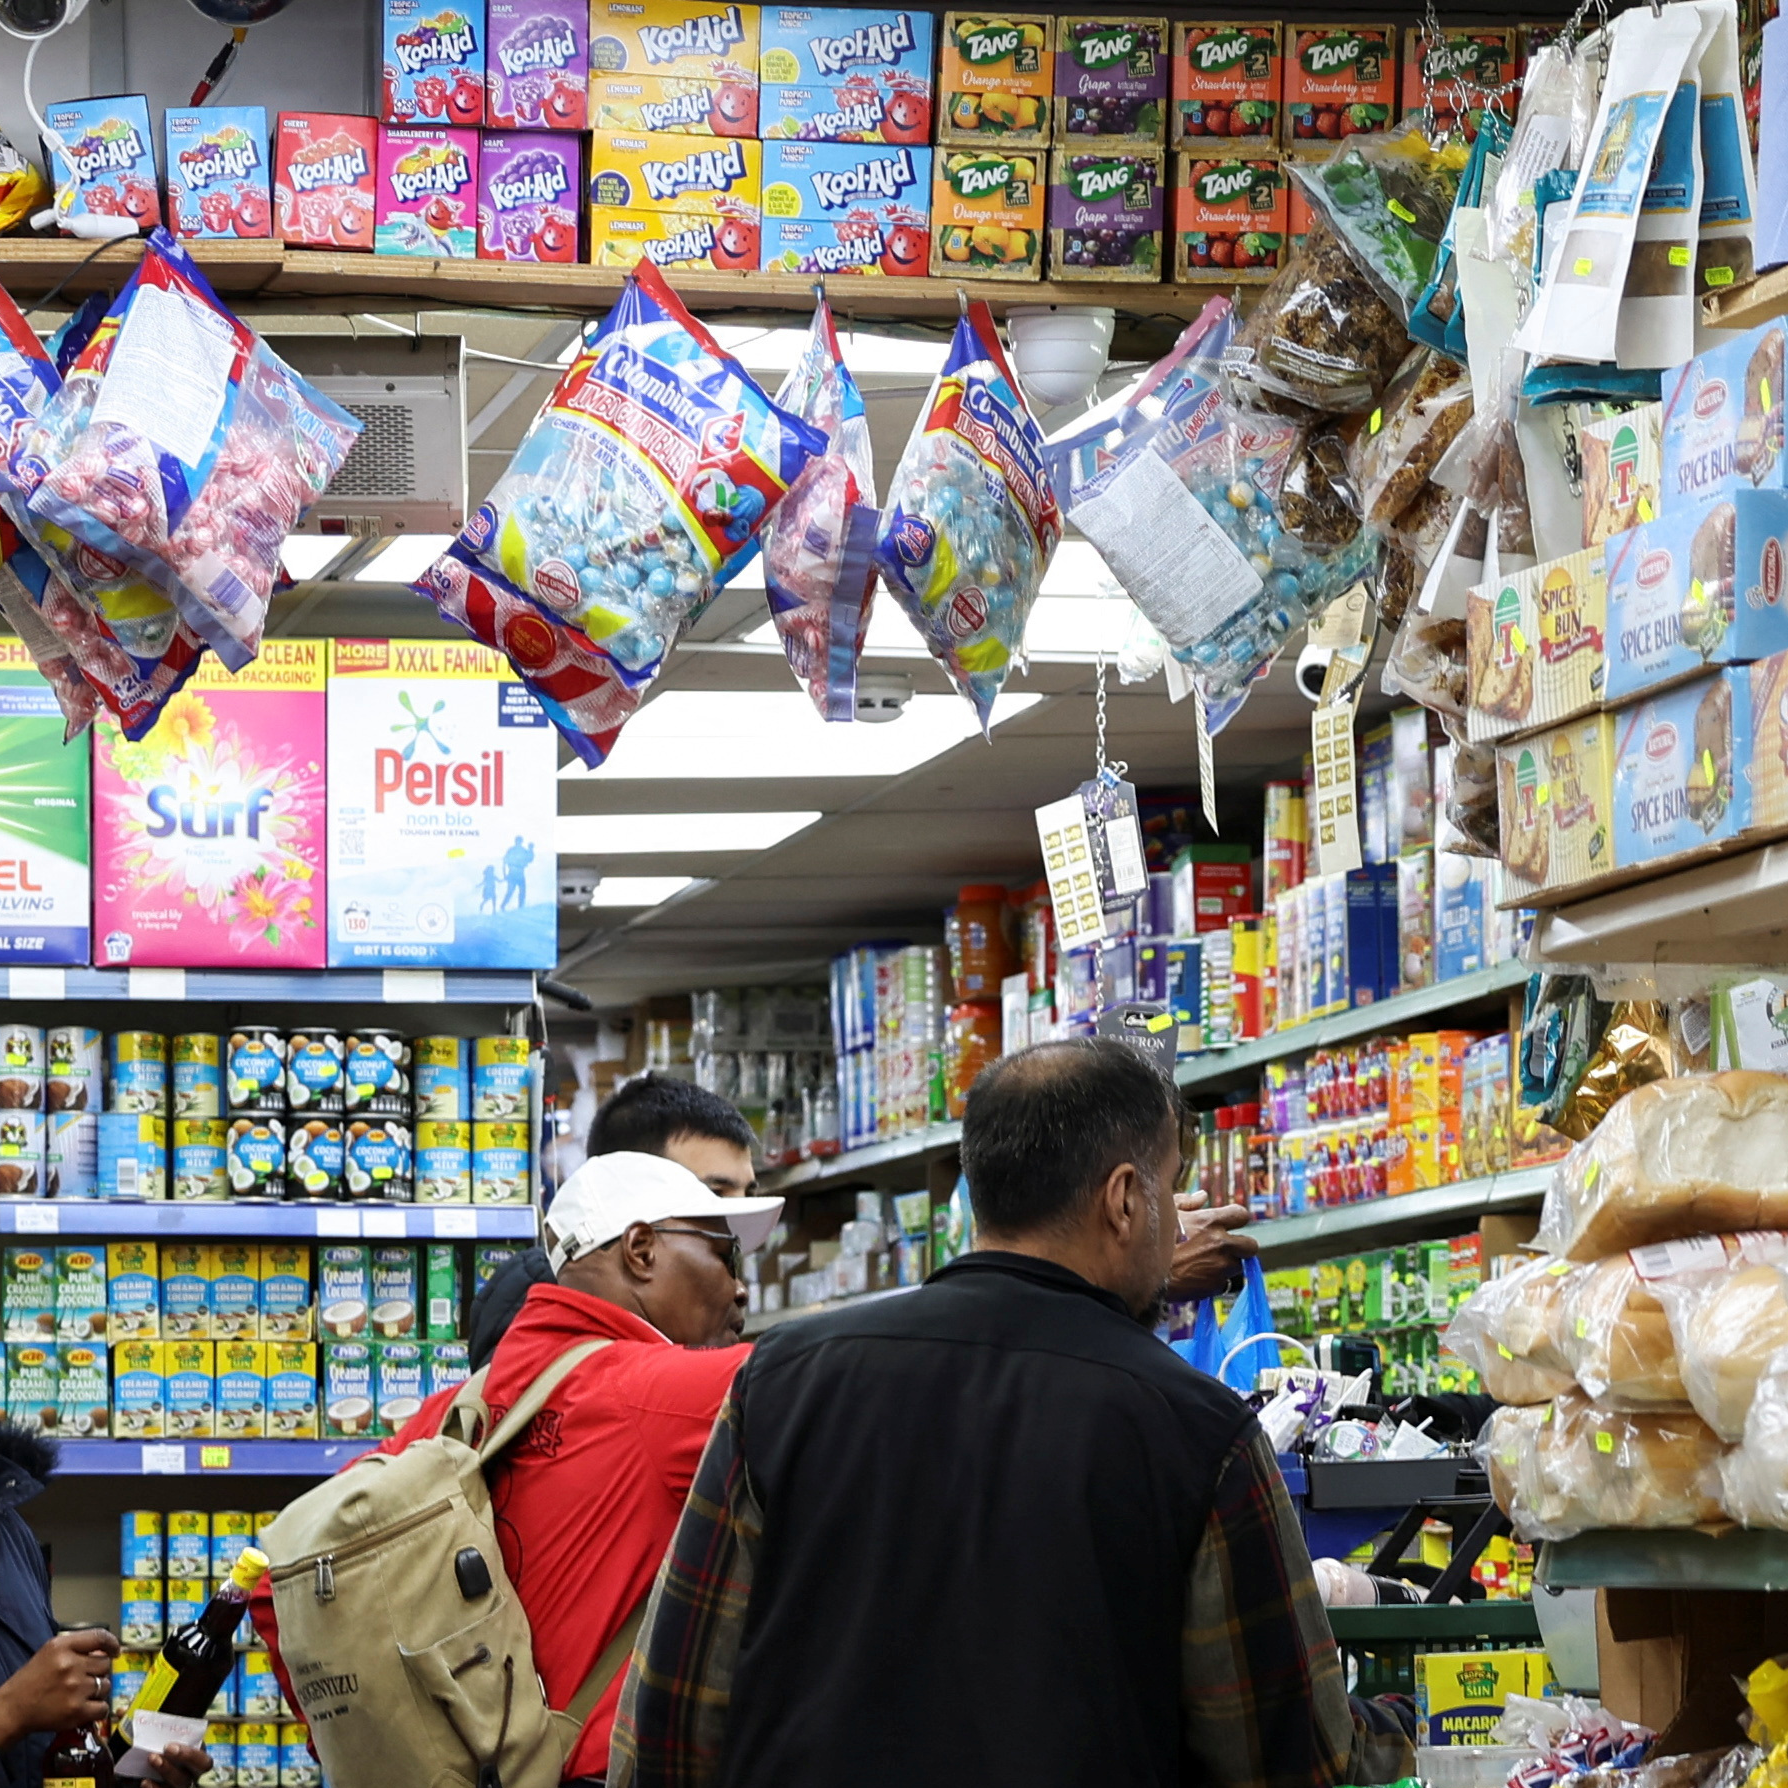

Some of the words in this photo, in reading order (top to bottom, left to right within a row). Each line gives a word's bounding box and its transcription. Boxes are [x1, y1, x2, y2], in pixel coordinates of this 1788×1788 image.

[388, 8, 412, 16] PUNCH
[492, 4, 513, 14] GRAPE
[608, 4, 645, 15] LEMONADE
[778, 11, 813, 21] TROPICAL
[966, 31, 1019, 60] TANG
[1079, 33, 1133, 63] TANG
[1196, 37, 1248, 67] TANG
[1020, 47, 1037, 65] 2
[1134, 50, 1150, 67] 2
[1250, 53, 1266, 71] 2
[1307, 40, 1360, 70] TANG
[961, 69, 1002, 87] Orange
[1078, 74, 1112, 96] Grape
[1190, 76, 1248, 93] Strawberry
[606, 85, 643, 95] LEMONADE
[1301, 79, 1359, 96] Strawberry
[52, 111, 83, 122] TROPICAL
[52, 121, 75, 129] PUNCH
[171, 117, 201, 127] TROPICAL
[171, 125, 194, 134] PUNCH
[386, 129, 435, 140] SHARKLEBERRY
[484, 139, 505, 149] GRAPE
[612, 139, 648, 149] LEMONADE
[957, 165, 1011, 195] TANG
[1077, 167, 1129, 197] TANG
[952, 203, 993, 222] Orange
[1074, 206, 1108, 227] Grape
[1195, 206, 1252, 225] Strawberry
[605, 350, 705, 424] Colombina
[1676, 448, 1710, 495] SPICE
[1540, 586, 1573, 615] SPICE
[1554, 609, 1582, 637] BUN
[1619, 624, 1657, 664] SPICE
[1658, 612, 1685, 649] BUN
[266, 644, 316, 666] CLEAN
[335, 642, 388, 659] MORE
[394, 646, 440, 673] XXXL
[442, 647, 502, 674] FAMILY
[204, 670, 236, 683] LESS
[374, 747, 504, 813] Persil
[32, 797, 77, 808] ORIGINAL
[145, 783, 275, 839] Surf
[406, 813, 441, 827] non
[444, 811, 473, 827] bio
[399, 828, 430, 837] TOUGH
[432, 828, 447, 837] ON
[448, 829, 481, 838] STAINS
[131, 909, 164, 922] tropical
[165, 907, 183, 922] lily
[347, 917, 366, 930] 130
[13, 935, 45, 950] SIZE
[353, 944, 379, 956] DIRT
[380, 944, 392, 956] IS
[393, 944, 427, 956] GOOD
[235, 1057, 276, 1069] COCONUT
[68, 1272, 93, 1283] PURE
[322, 1267, 365, 1286] Creamed
[329, 1363, 371, 1381] Creamed
[1465, 1686, 1492, 1697] SUN
